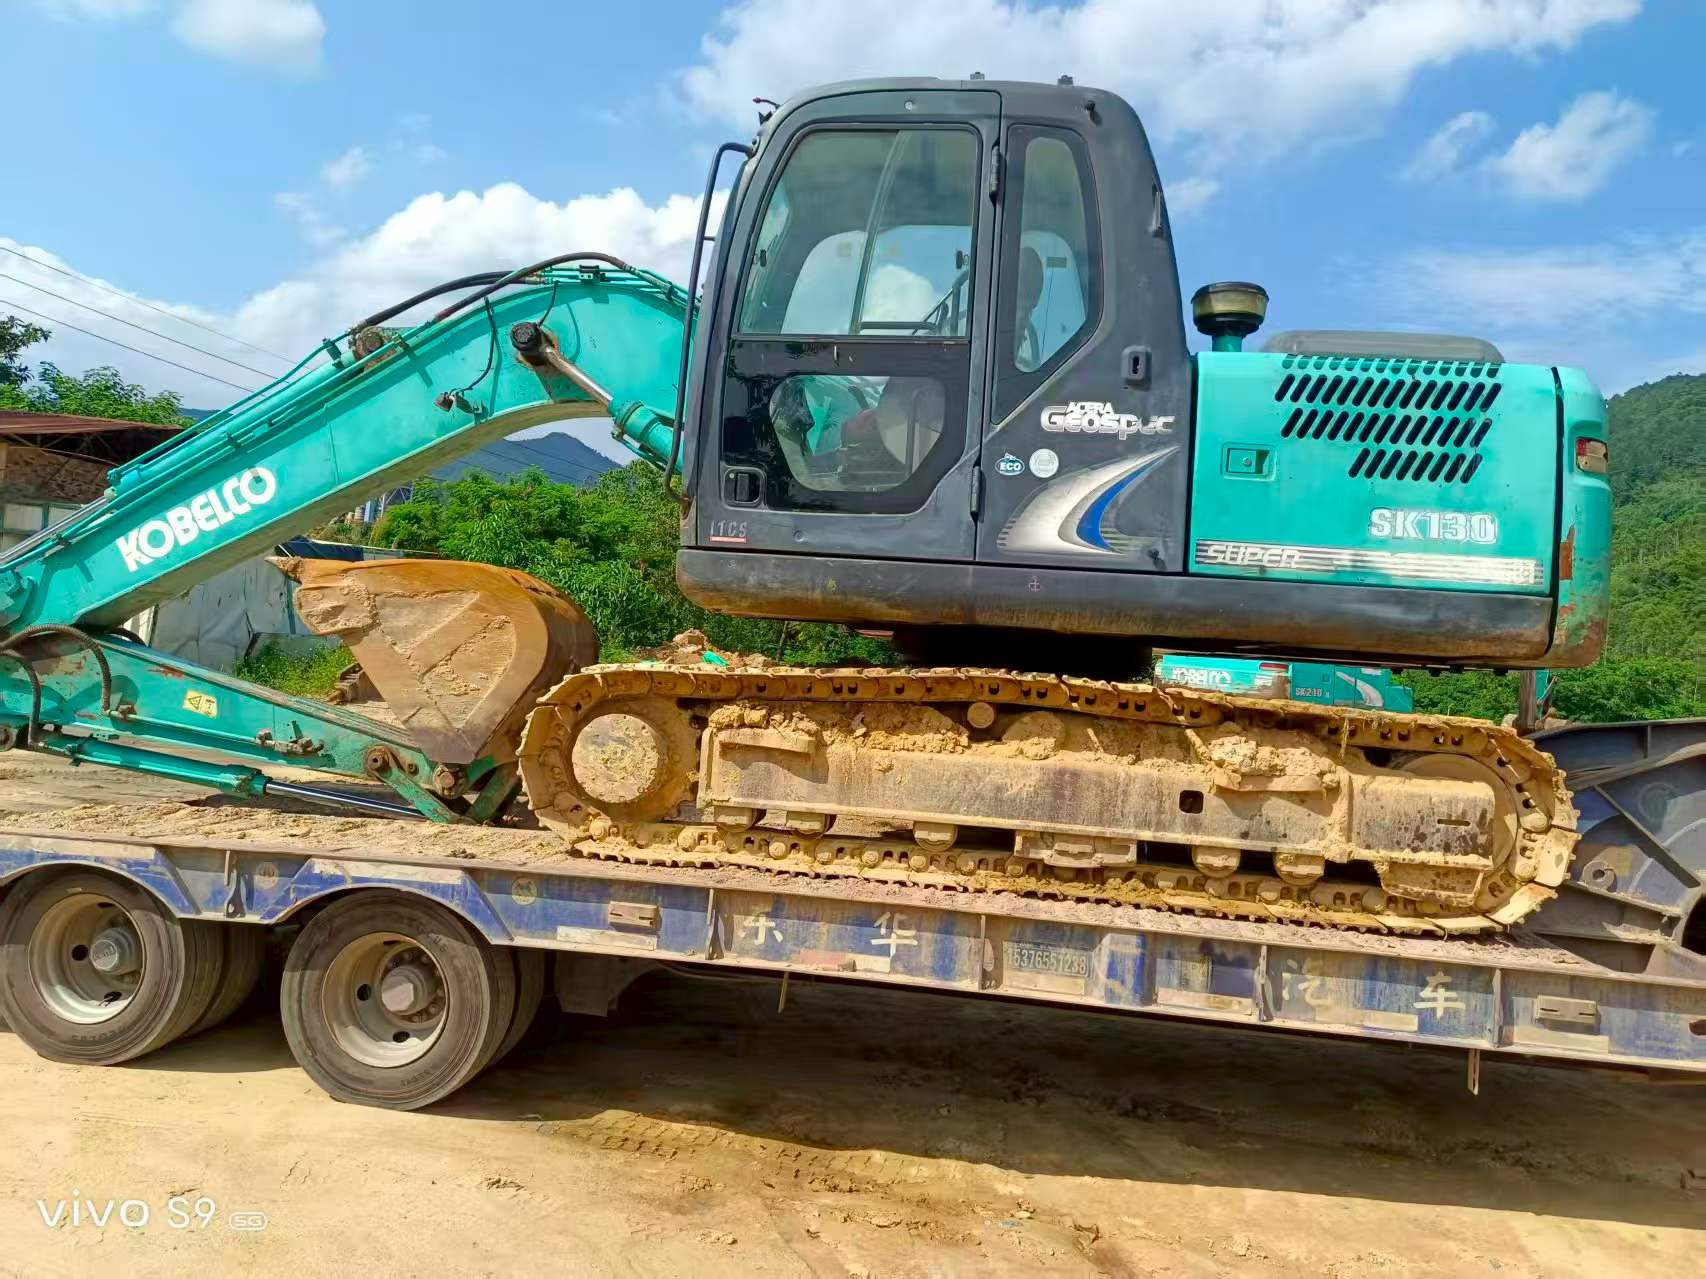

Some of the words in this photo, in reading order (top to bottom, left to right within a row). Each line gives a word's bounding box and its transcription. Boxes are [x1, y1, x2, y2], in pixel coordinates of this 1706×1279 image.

[999, 462, 1021, 471] ECO
[115, 466, 276, 573] KOBELCO
[710, 519, 747, 537] ITCS
[1368, 506, 1498, 544] SK130
[1207, 544, 1301, 569] SUPER
